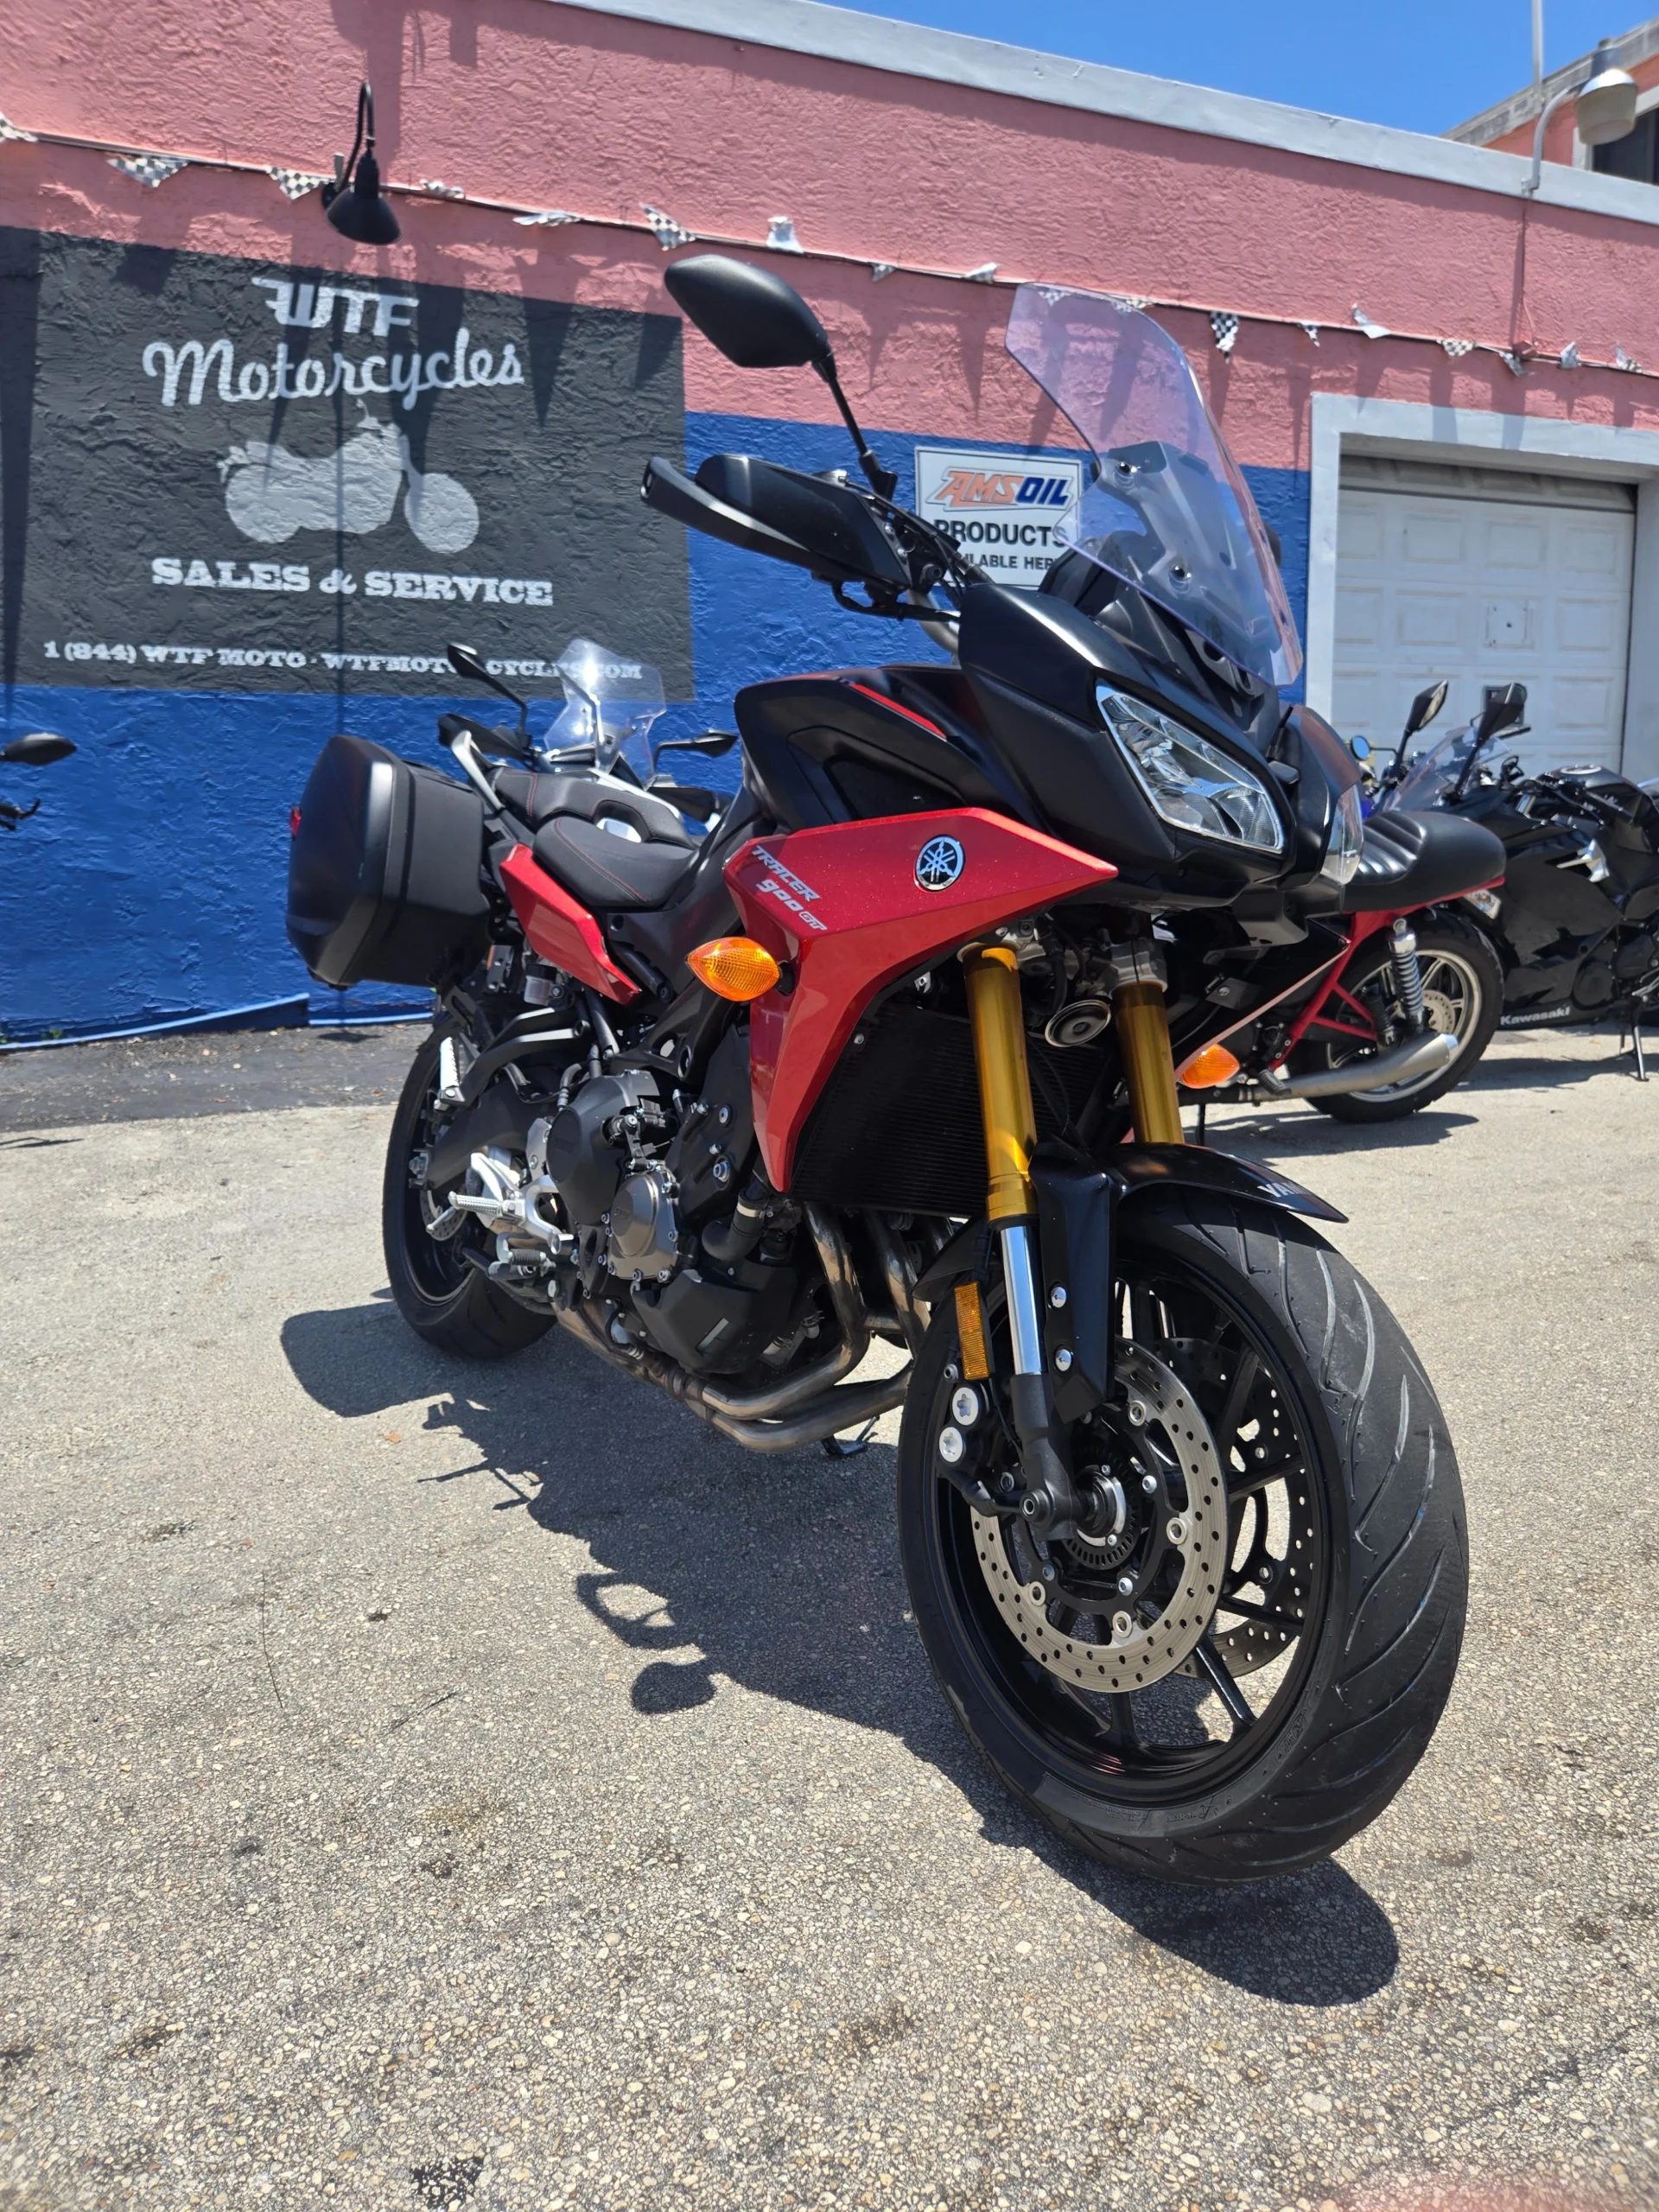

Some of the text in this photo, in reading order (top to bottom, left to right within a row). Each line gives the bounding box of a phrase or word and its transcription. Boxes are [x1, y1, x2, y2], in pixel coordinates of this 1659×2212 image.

[251, 276, 419, 336] WTF
[143, 327, 524, 410] Motorcycles
[935, 471, 1070, 507] AMSOIL
[934, 519, 1070, 547] PRODUCTS
[151, 557, 554, 606] SALES & SERVICE
[1024, 556, 1058, 570] HER
[44, 641, 60, 658] 1
[64, 642, 137, 664] (844)
[140, 645, 213, 664] WTF
[217, 649, 307, 667] MOTO
[752, 844, 820, 901] TRACER
[755, 879, 827, 931] 900 GT
[1500, 1004, 1570, 1026] Kawasaki
